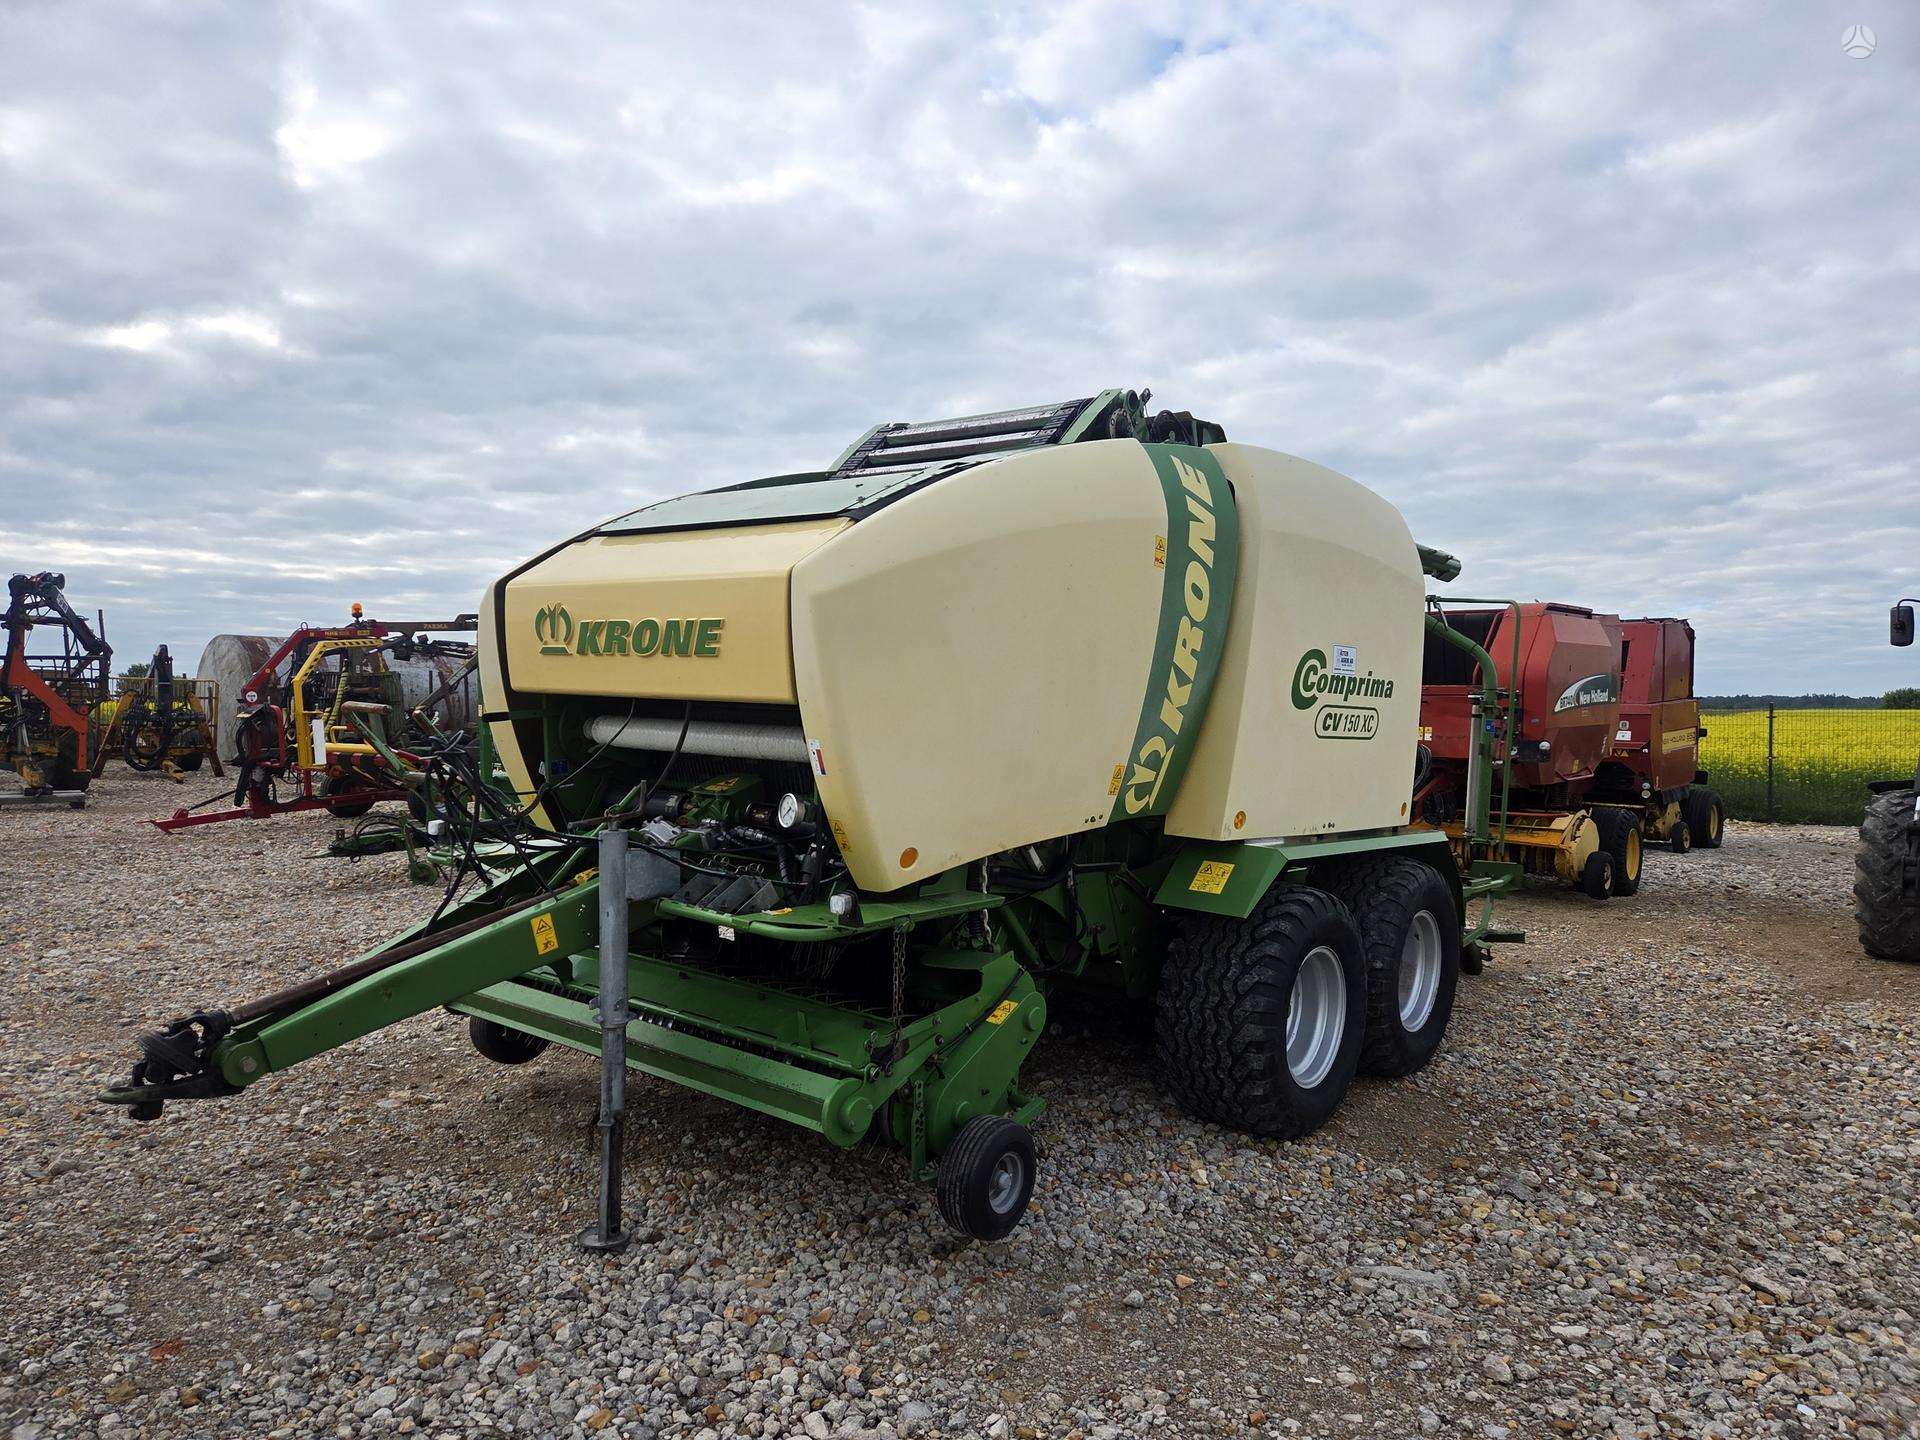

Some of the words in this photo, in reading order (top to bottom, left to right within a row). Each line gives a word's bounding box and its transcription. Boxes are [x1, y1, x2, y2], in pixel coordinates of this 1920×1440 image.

[1160, 454, 1216, 735] KRONE
[576, 618, 725, 657] KRONE
[1291, 649, 1394, 710] Comprima
[1579, 691, 1590, 705] New
[1591, 689, 1609, 703] Holland
[1322, 712, 1343, 731] CV
[1343, 714, 1360, 732] 150
[1360, 714, 1374, 732] XC
